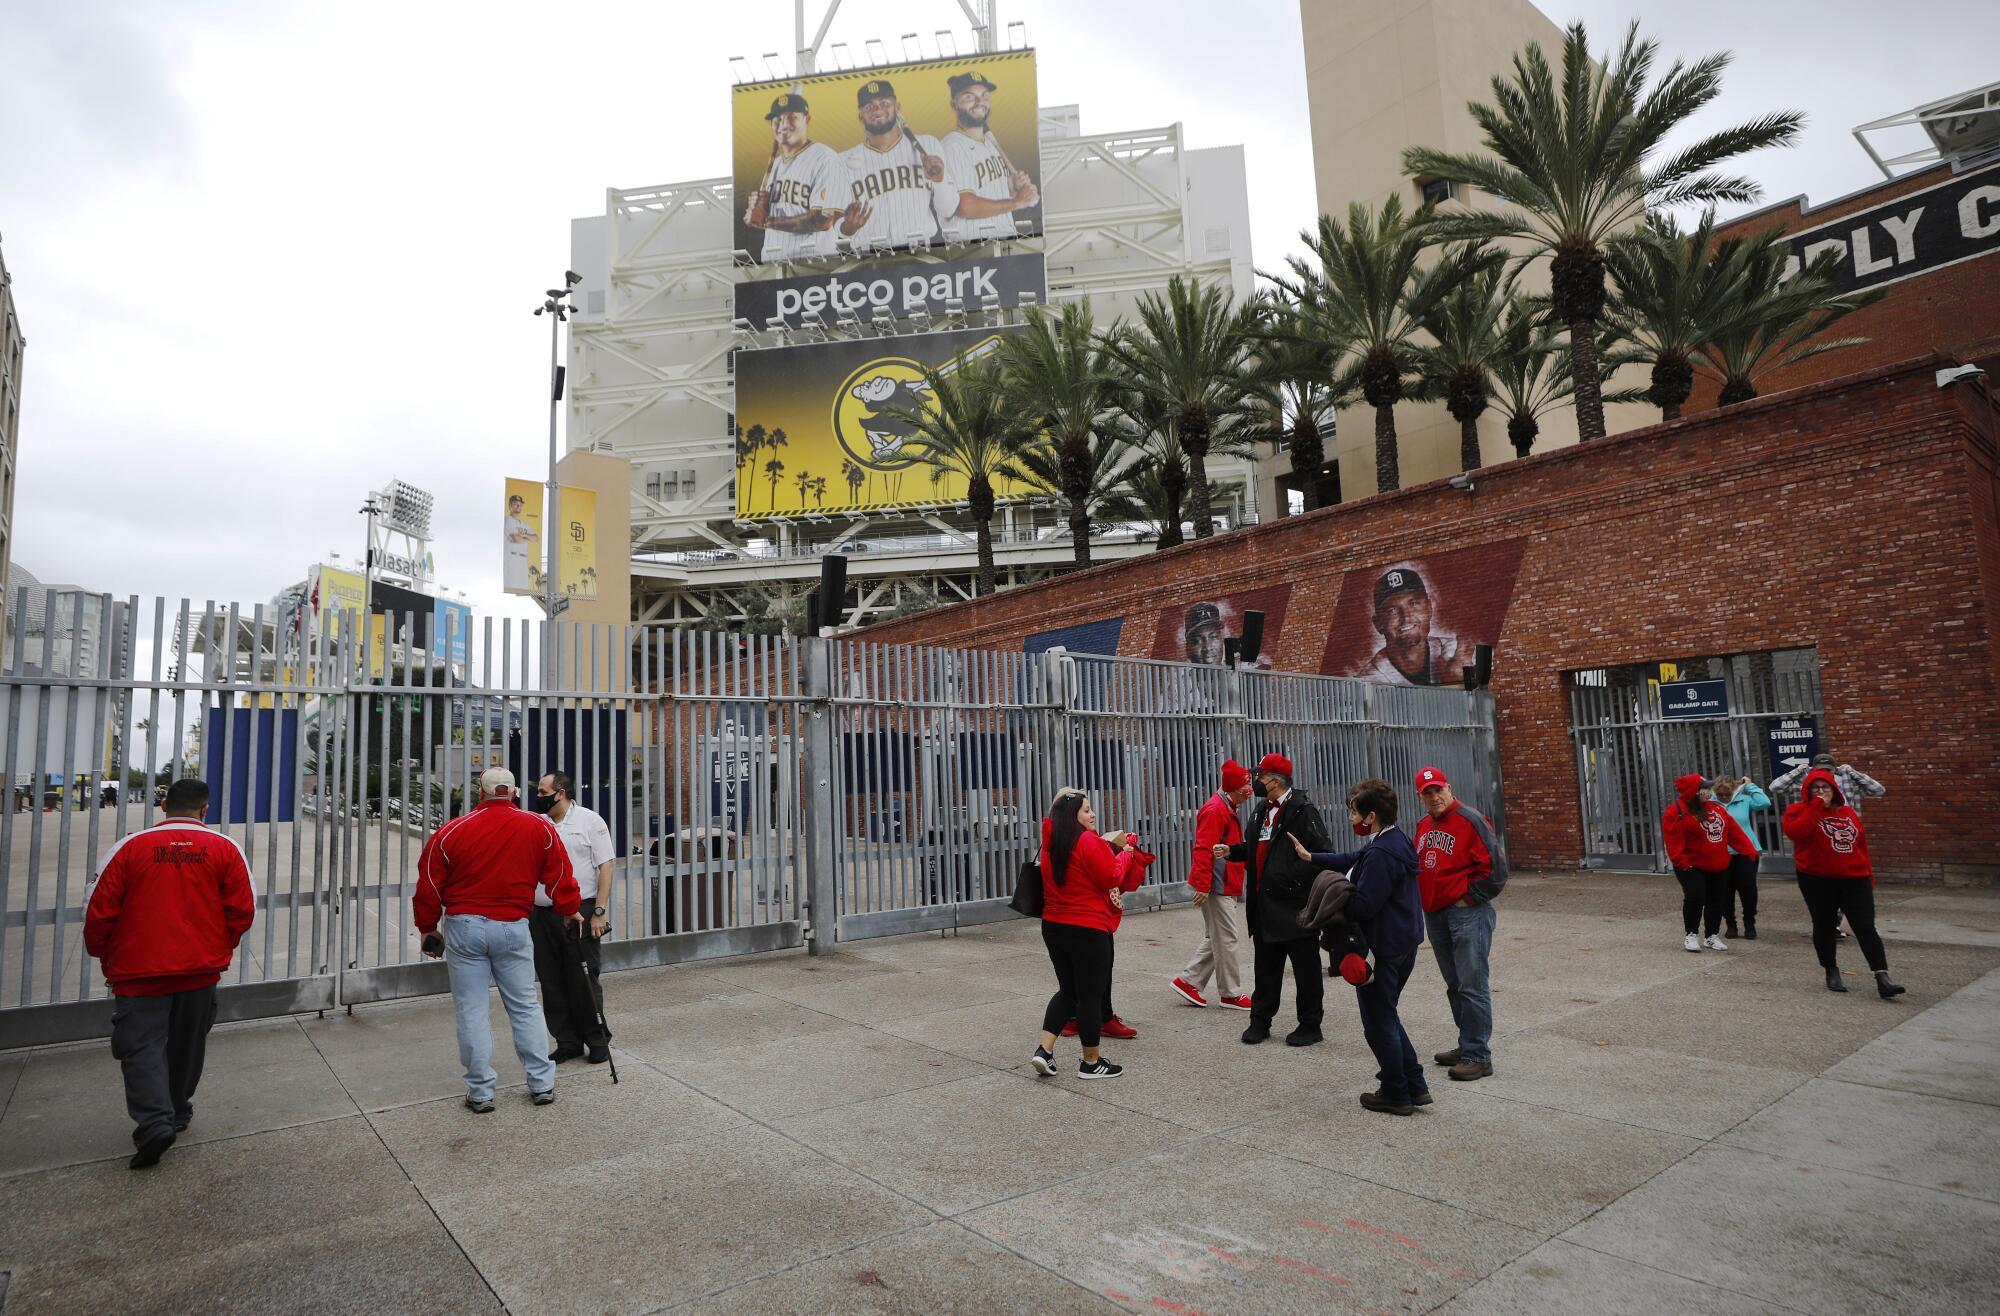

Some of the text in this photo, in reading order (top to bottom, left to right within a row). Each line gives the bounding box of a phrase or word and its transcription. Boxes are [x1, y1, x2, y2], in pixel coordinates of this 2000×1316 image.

[852, 164, 932, 201] PADRE
[776, 266, 999, 320] petco park
[373, 547, 418, 577] Viasat
[1668, 702, 1700, 710] GASLAMP
[1780, 720, 1800, 729] ADA
[1770, 729, 1814, 740] STROLLER
[1778, 744, 1808, 754] ENTRY
[1427, 830, 1456, 856] STATE
